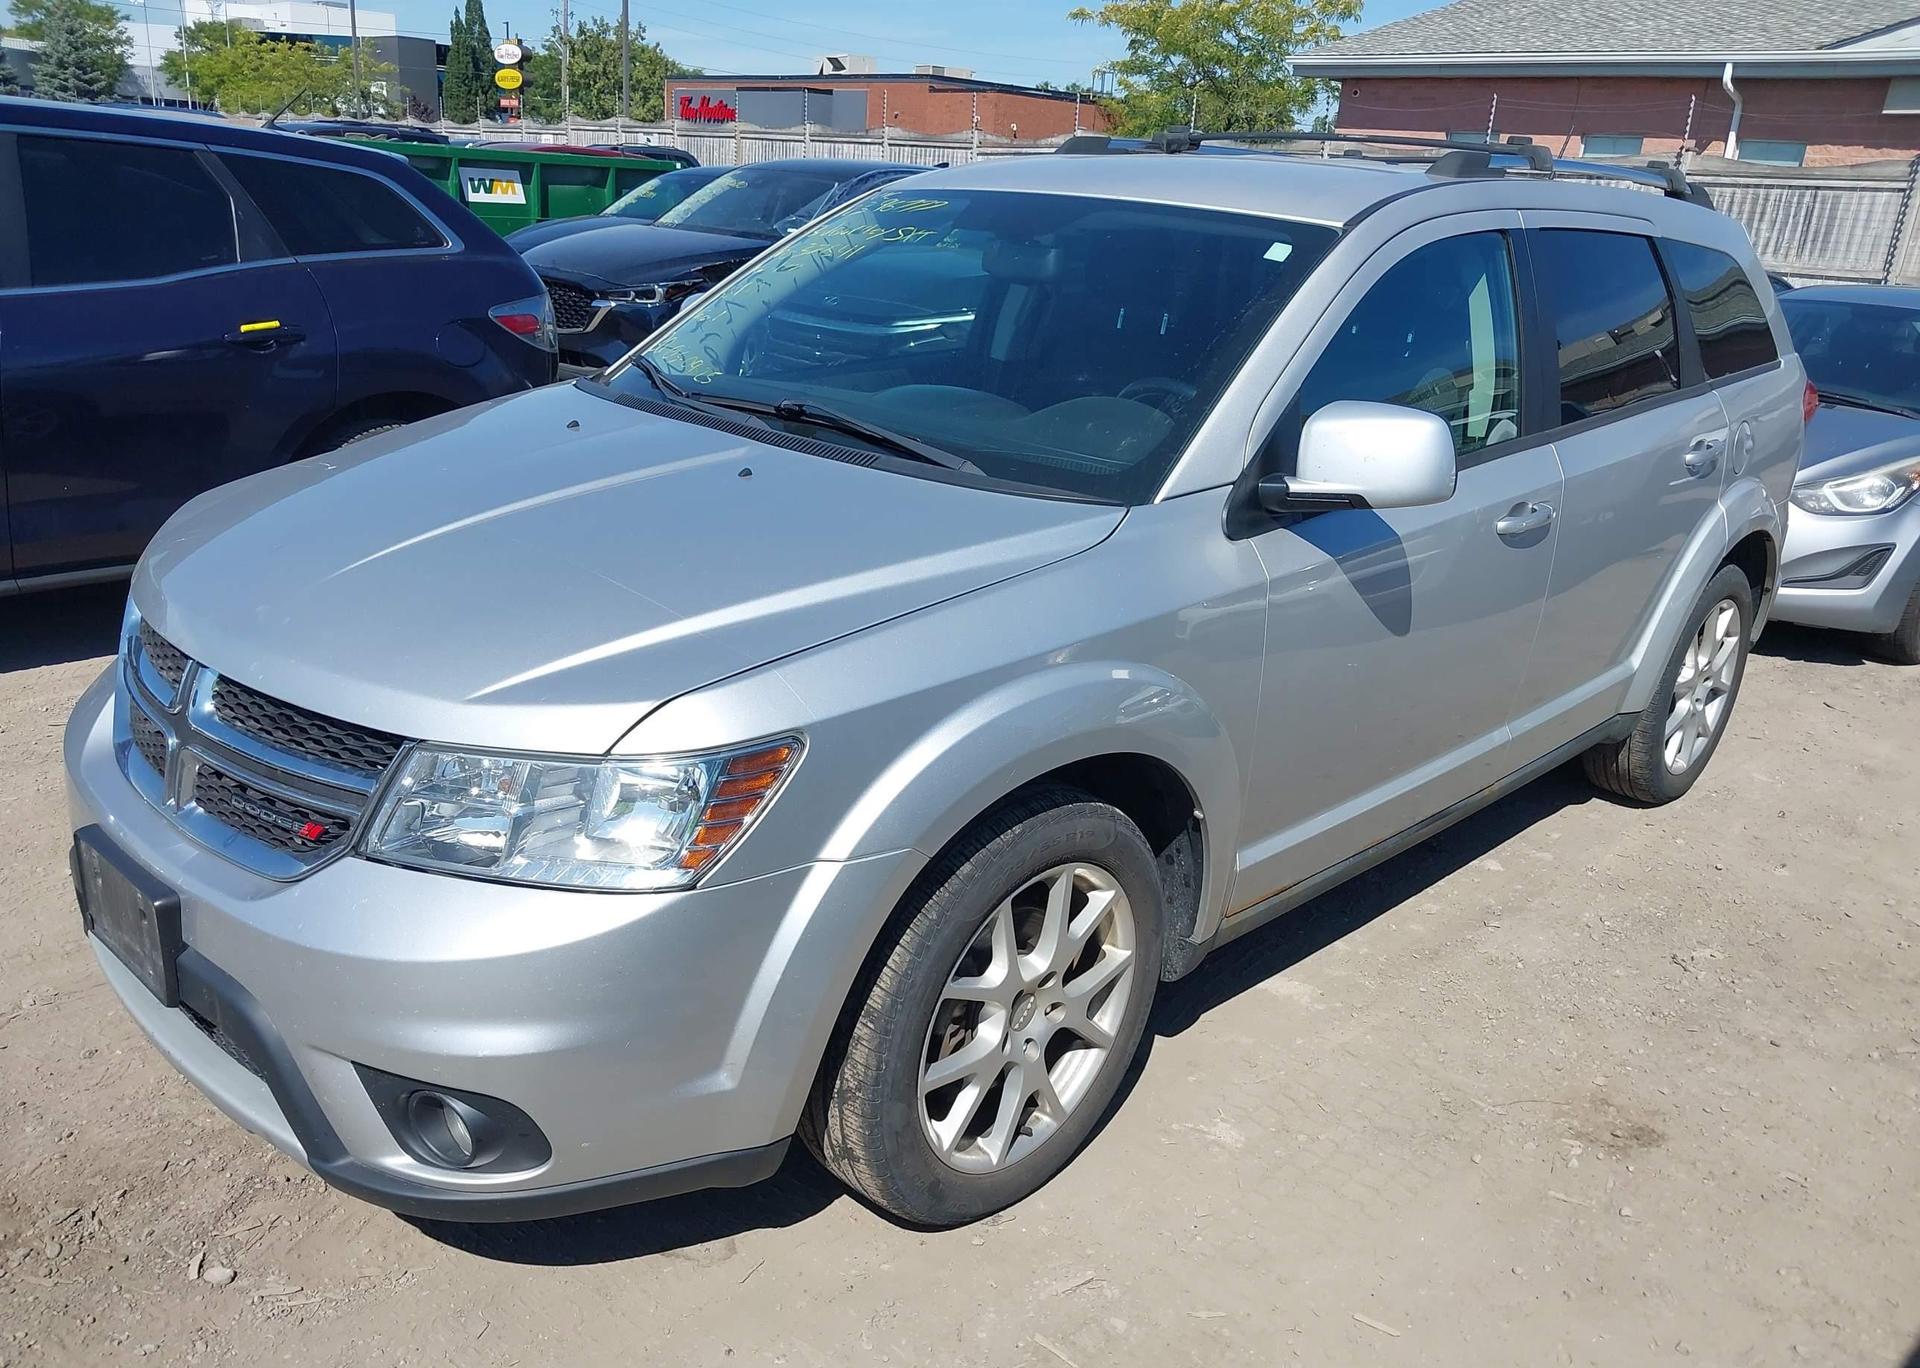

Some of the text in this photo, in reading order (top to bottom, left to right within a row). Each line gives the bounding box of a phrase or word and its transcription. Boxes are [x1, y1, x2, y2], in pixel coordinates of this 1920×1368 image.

[679, 95, 737, 122] Tim Hortons
[468, 177, 516, 196] WM
[883, 227, 938, 243] SXT
[231, 794, 305, 831] DODGE
